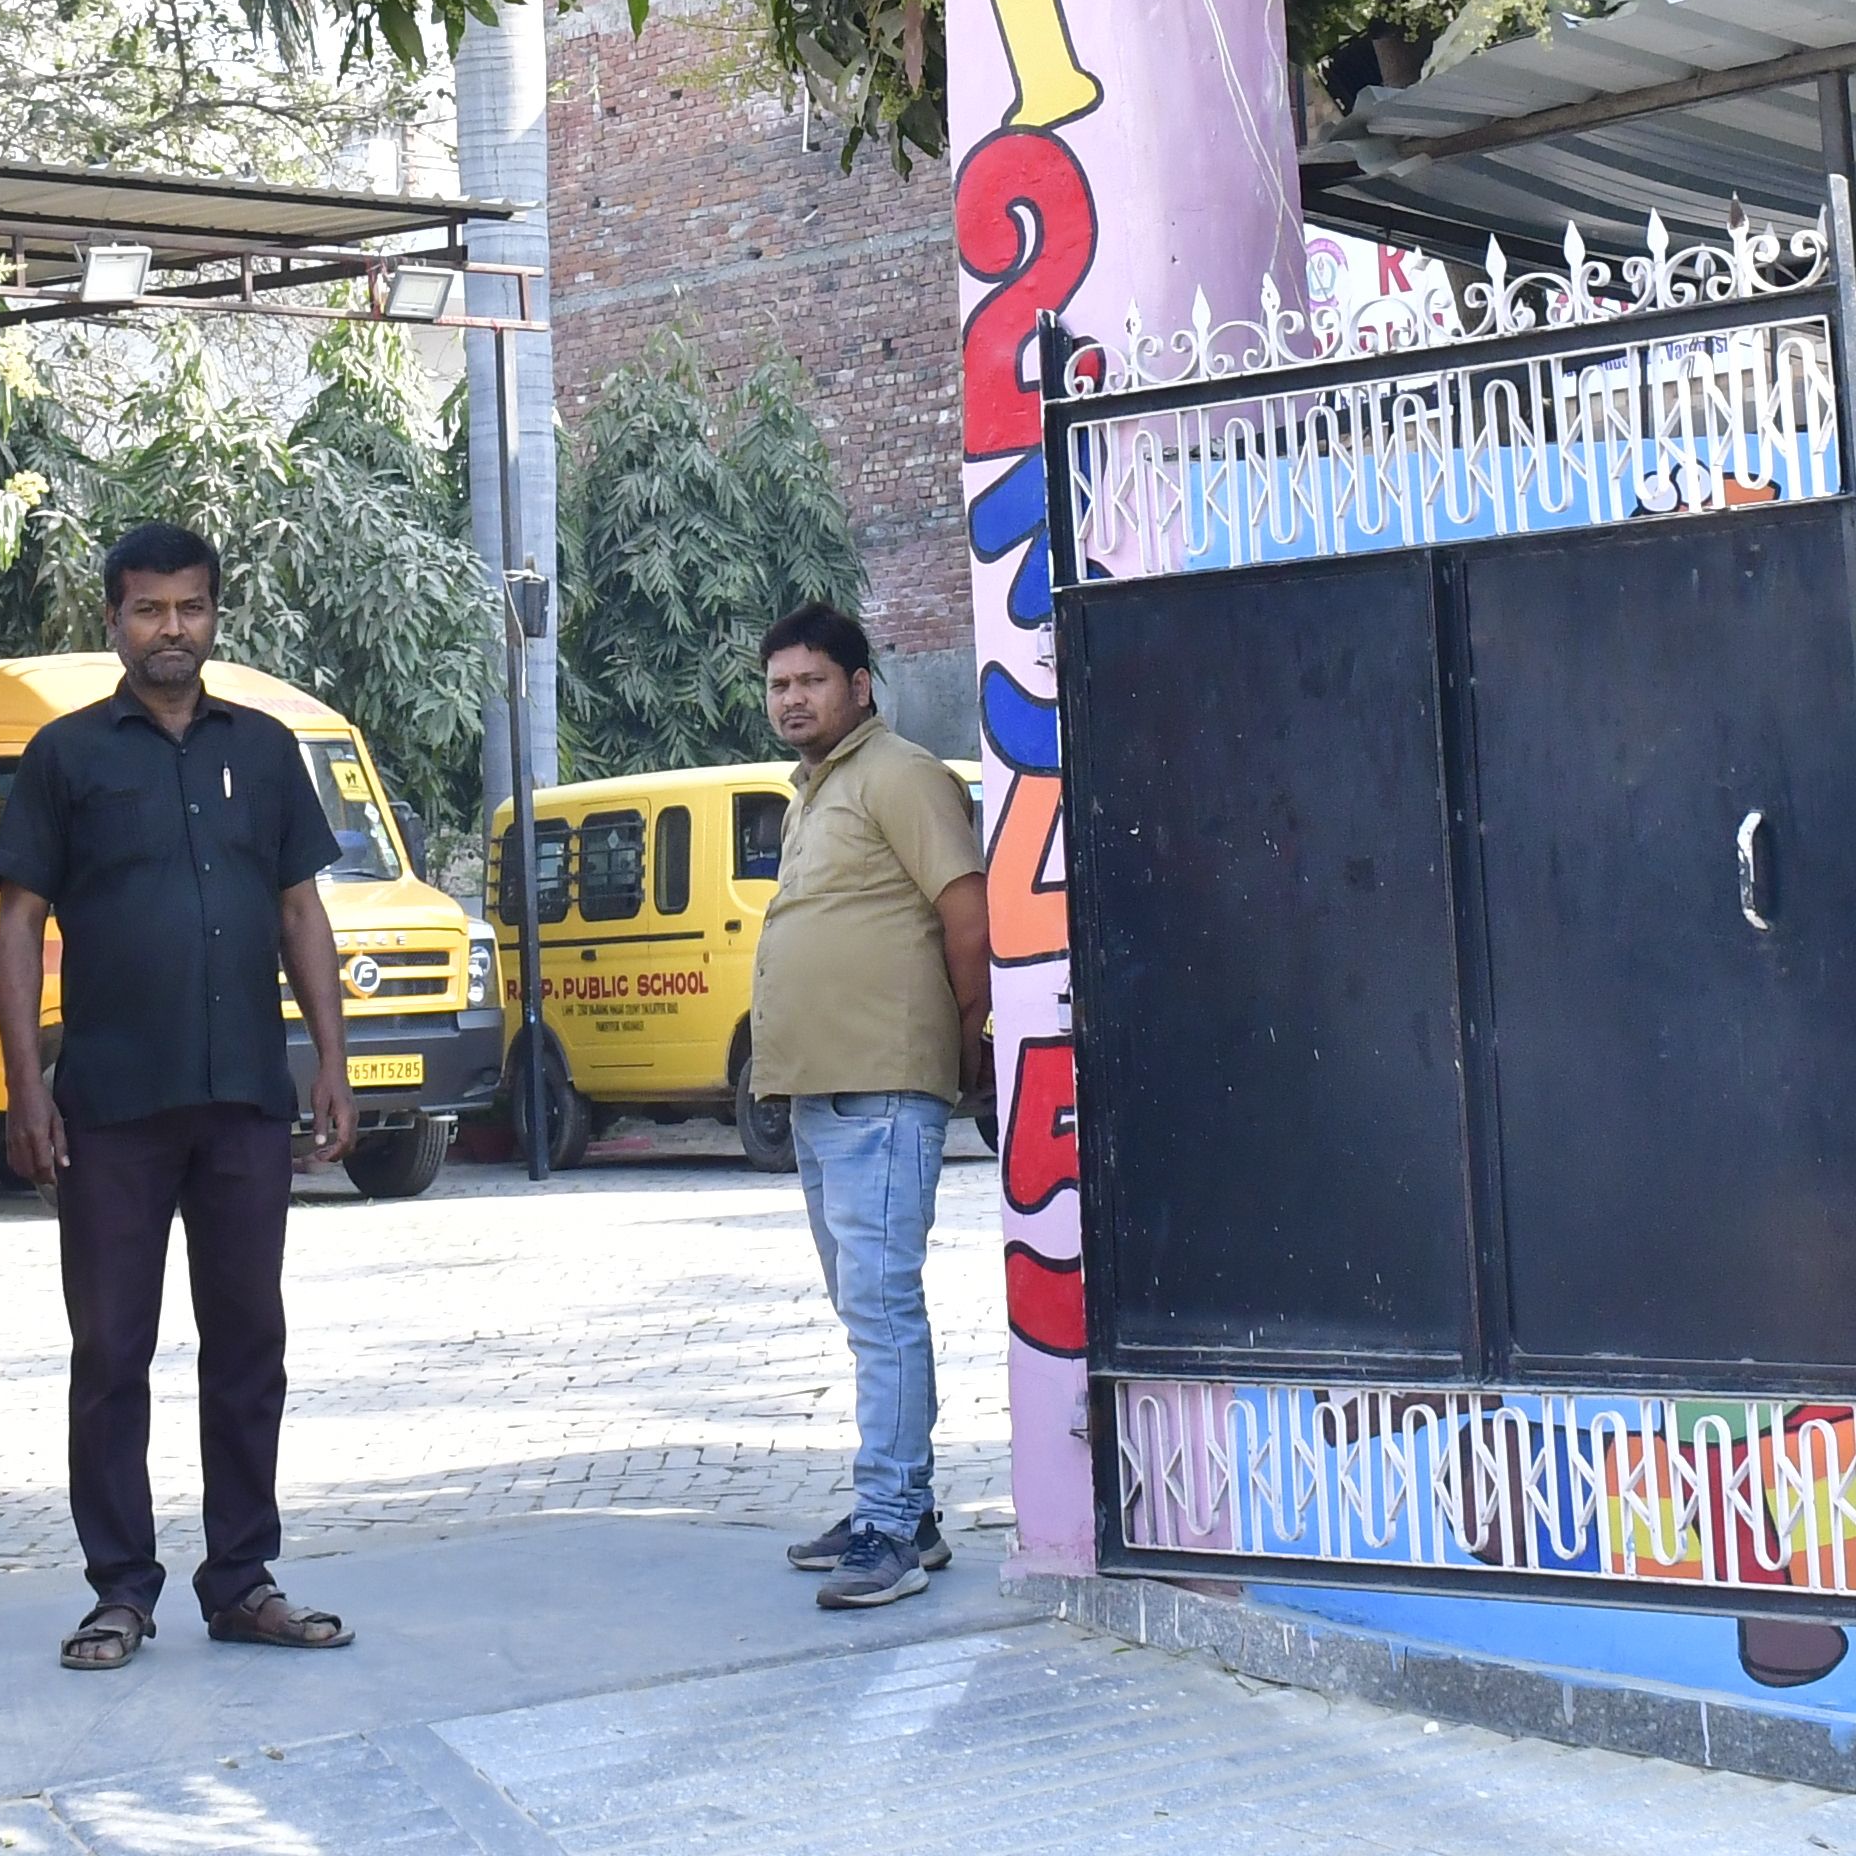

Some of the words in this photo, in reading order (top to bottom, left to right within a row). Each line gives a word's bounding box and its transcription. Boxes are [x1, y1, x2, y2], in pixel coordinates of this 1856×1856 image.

[563, 974, 629, 1000] PUBLIC
[637, 970, 709, 997] SCHOOL
[347, 1061, 420, 1080] P65MT5285
